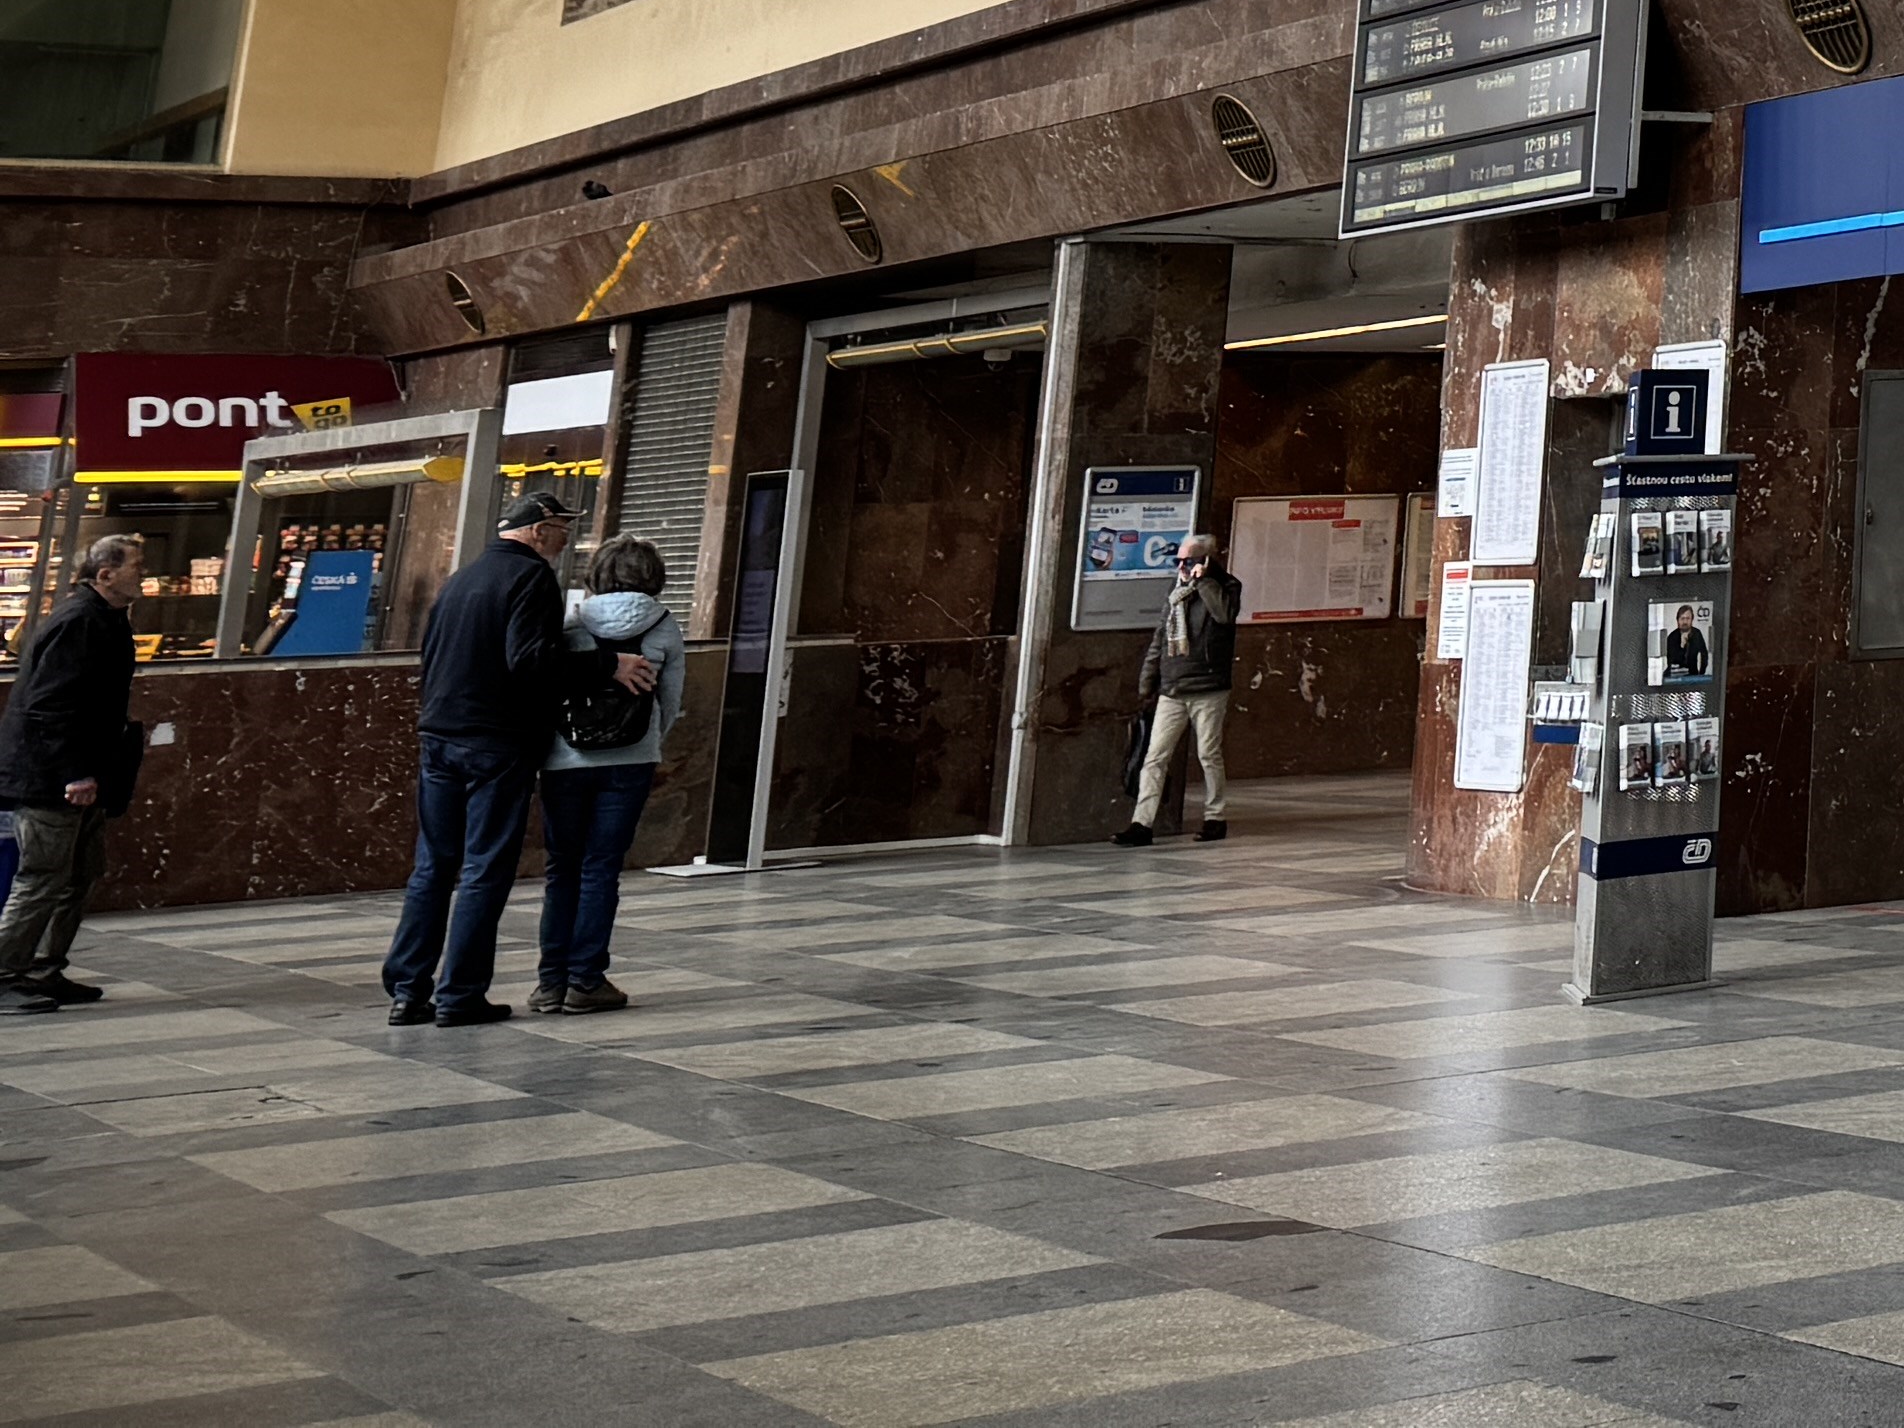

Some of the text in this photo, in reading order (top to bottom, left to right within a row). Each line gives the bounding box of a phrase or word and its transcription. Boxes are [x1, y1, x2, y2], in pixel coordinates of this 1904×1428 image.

[127, 391, 294, 438] pont
[311, 403, 342, 417] to
[1626, 472, 1733, 486] Šťastnou cestu vlakem!
